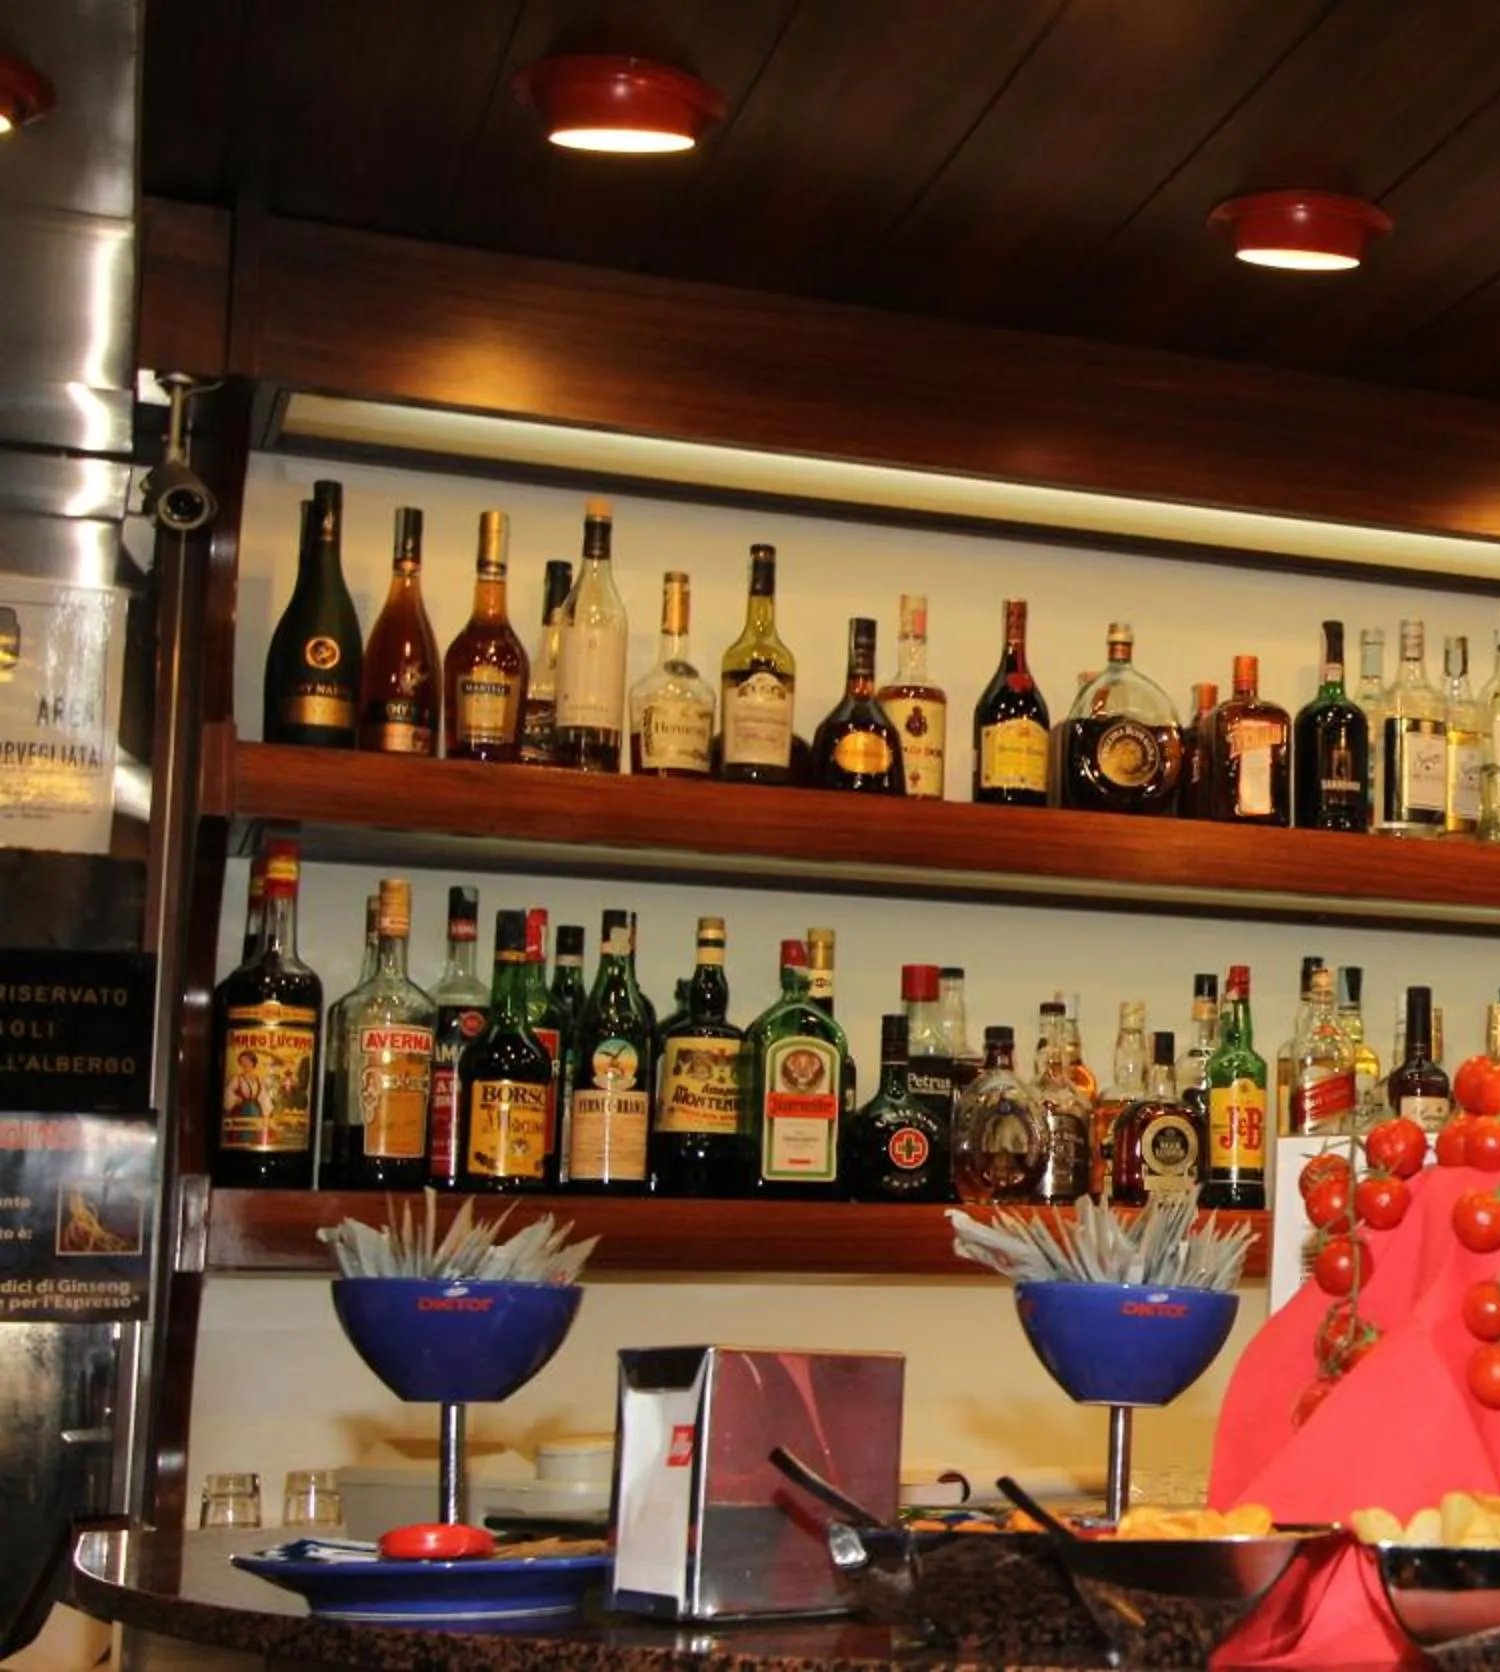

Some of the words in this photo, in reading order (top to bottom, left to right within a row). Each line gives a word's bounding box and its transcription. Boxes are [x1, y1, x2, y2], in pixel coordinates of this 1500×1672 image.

[0, 1018, 54, 1040] OLI
[366, 1032, 432, 1051] AVERNA
[1219, 1106, 1263, 1151] J&B
[58, 1279, 131, 1297] Ginseng
